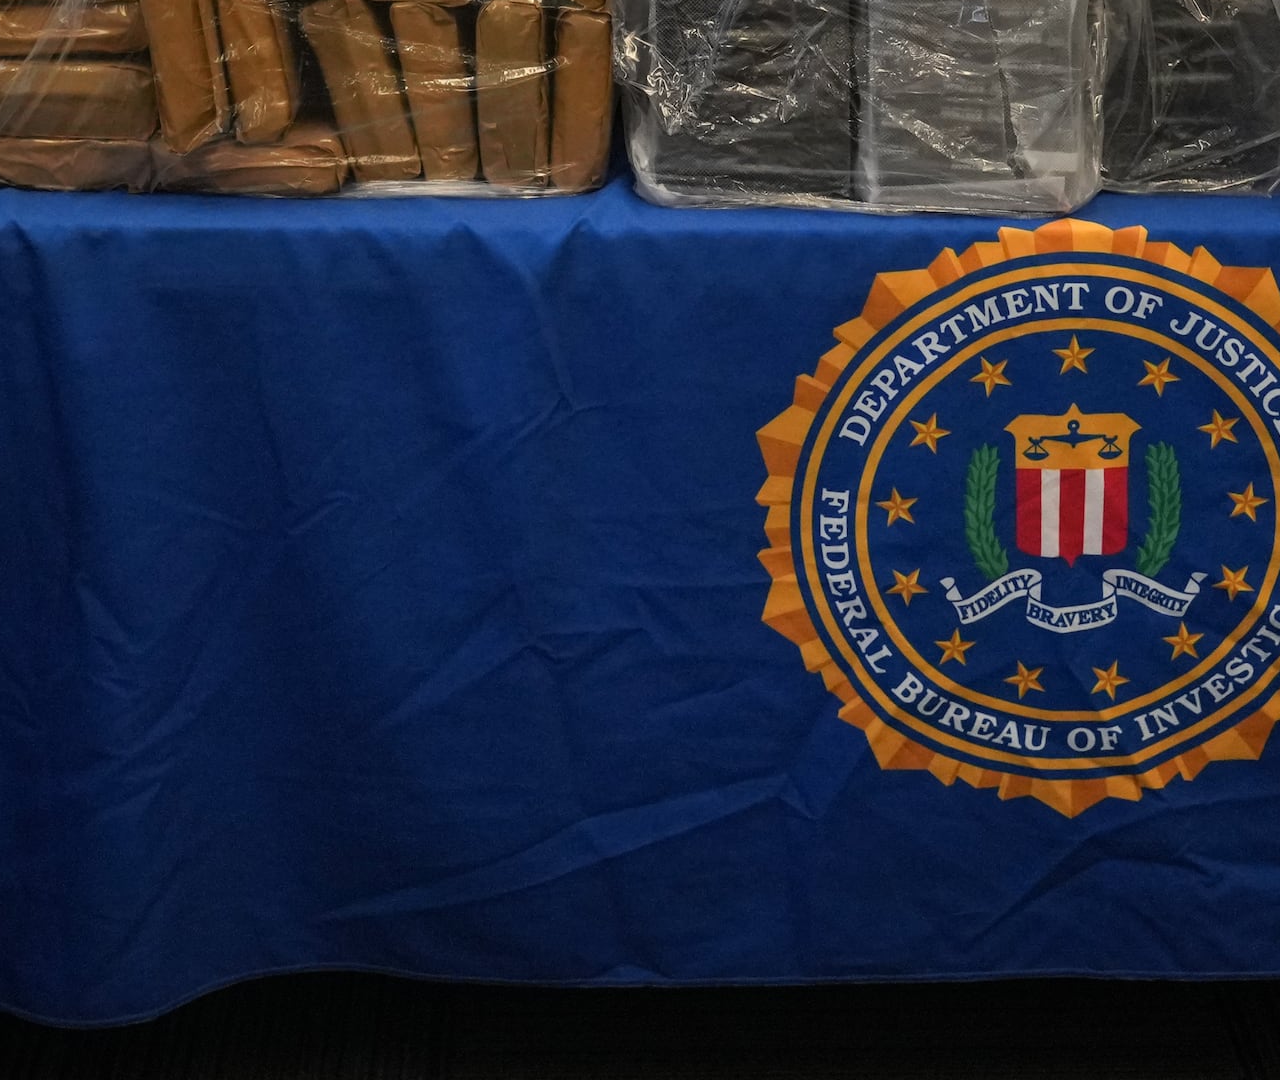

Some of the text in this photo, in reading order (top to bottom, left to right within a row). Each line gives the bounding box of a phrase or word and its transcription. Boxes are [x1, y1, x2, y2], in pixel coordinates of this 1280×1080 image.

[839, 283, 1090, 446] DEPARTMENT
[1104, 286, 1165, 320] OF
[819, 487, 893, 674] FEDERAL
[890, 672, 1051, 752] BUREAU
[1066, 724, 1123, 752] OF
[957, 574, 1188, 629] FIDELITY BRAVERY INTEGRITY
